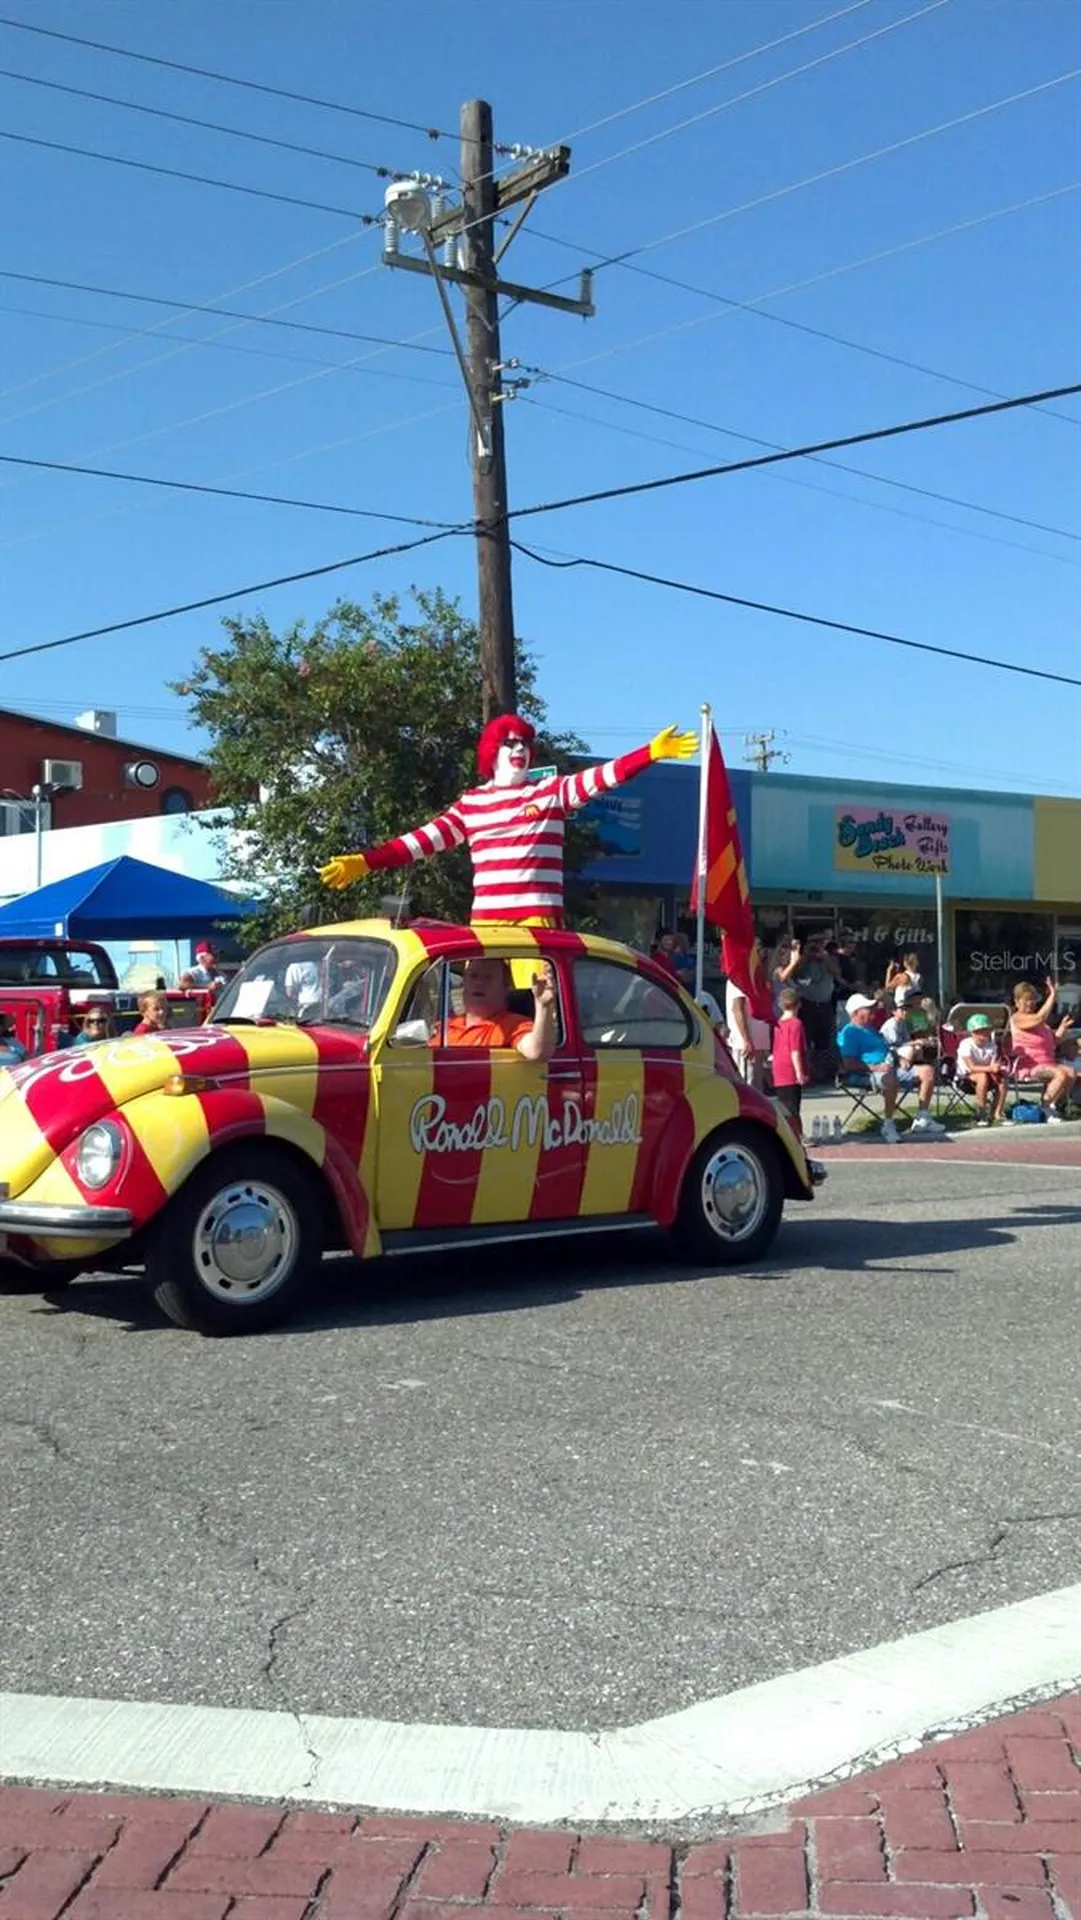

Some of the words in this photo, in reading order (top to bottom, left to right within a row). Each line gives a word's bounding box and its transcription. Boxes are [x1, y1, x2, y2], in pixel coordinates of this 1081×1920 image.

[894, 927, 936, 945] Gifts
[409, 1094, 508, 1154] Ronald
[512, 1093, 642, 1151] McDonald
